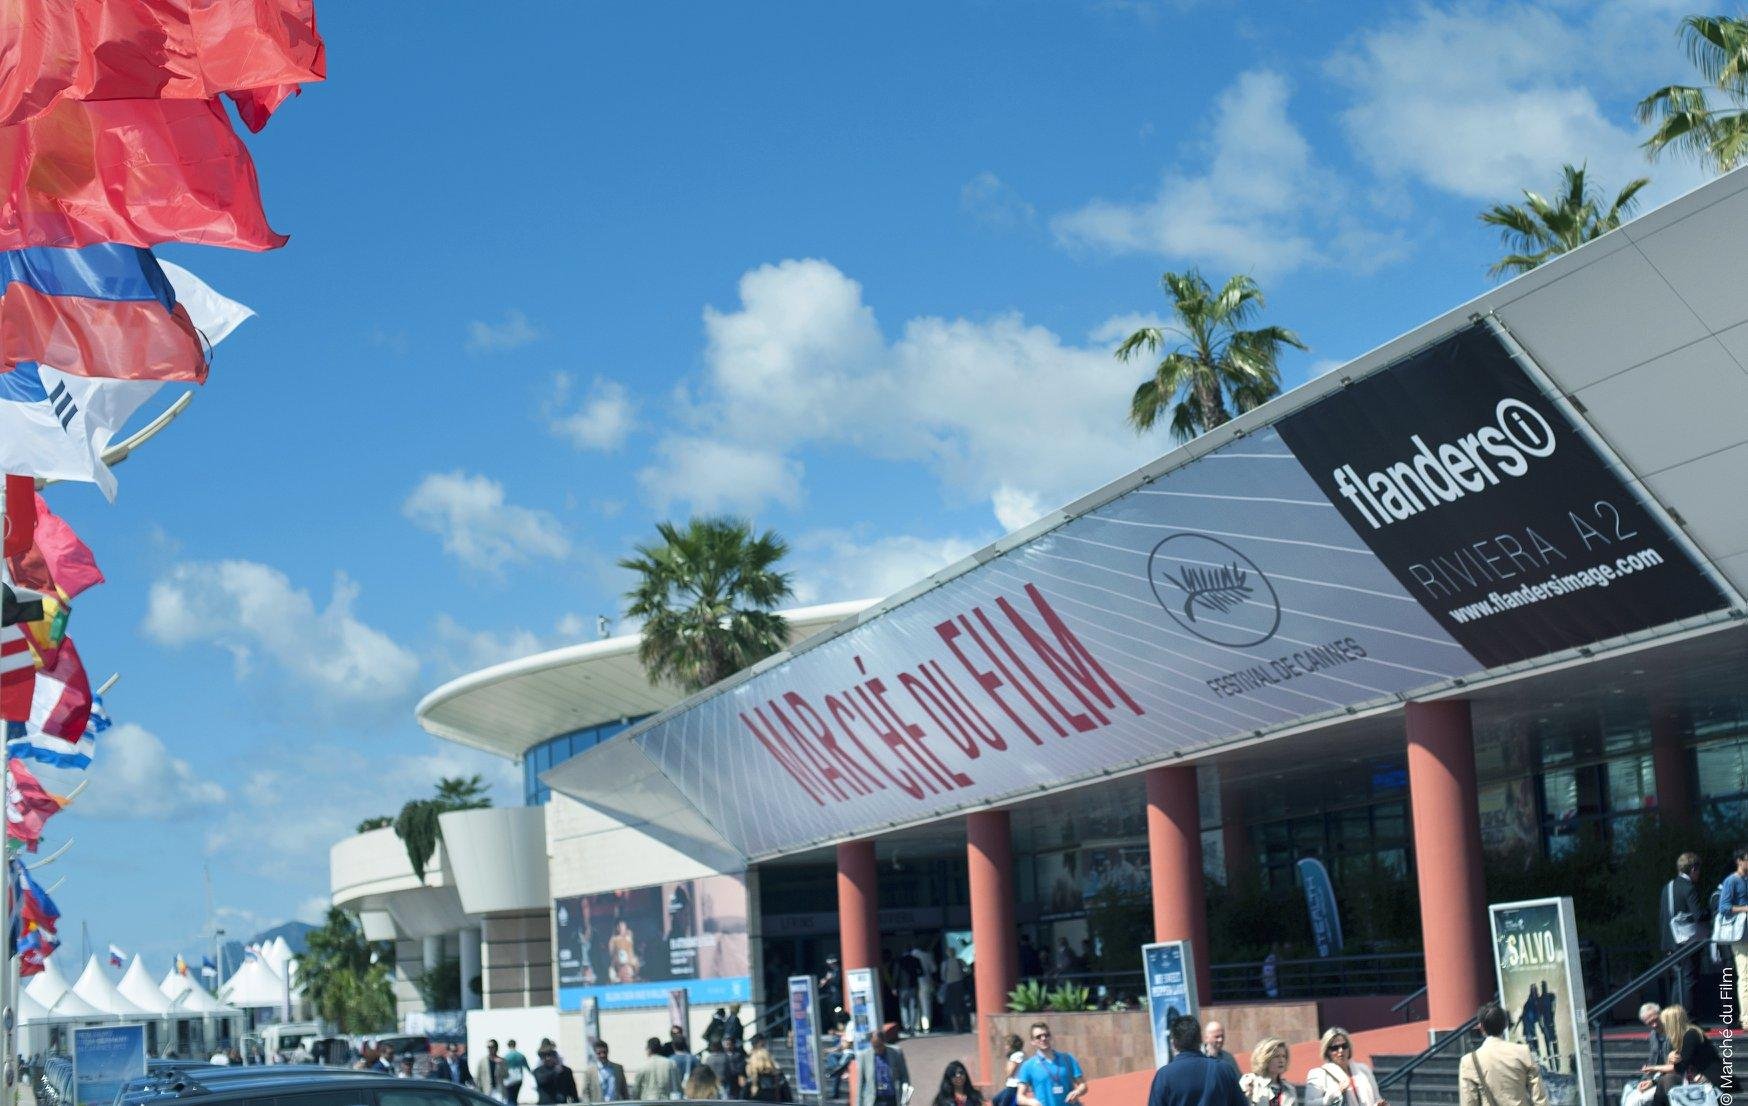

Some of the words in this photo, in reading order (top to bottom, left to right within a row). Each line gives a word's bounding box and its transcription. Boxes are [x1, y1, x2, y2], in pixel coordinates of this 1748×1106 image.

[1333, 426, 1528, 530] flanders
[1408, 527, 1567, 600] RIVIERA
[1569, 501, 1638, 551] A2
[1449, 548, 1665, 624] www.flandersimage.com
[897, 660, 1007, 760] DU
[933, 582, 1146, 747] FILM
[1205, 664, 1281, 699] FESTIVAL
[1270, 656, 1303, 680] DE
[1293, 637, 1368, 673] CANNES
[740, 656, 976, 807] MARCHÉ
[1506, 930, 1555, 967] SALVO
